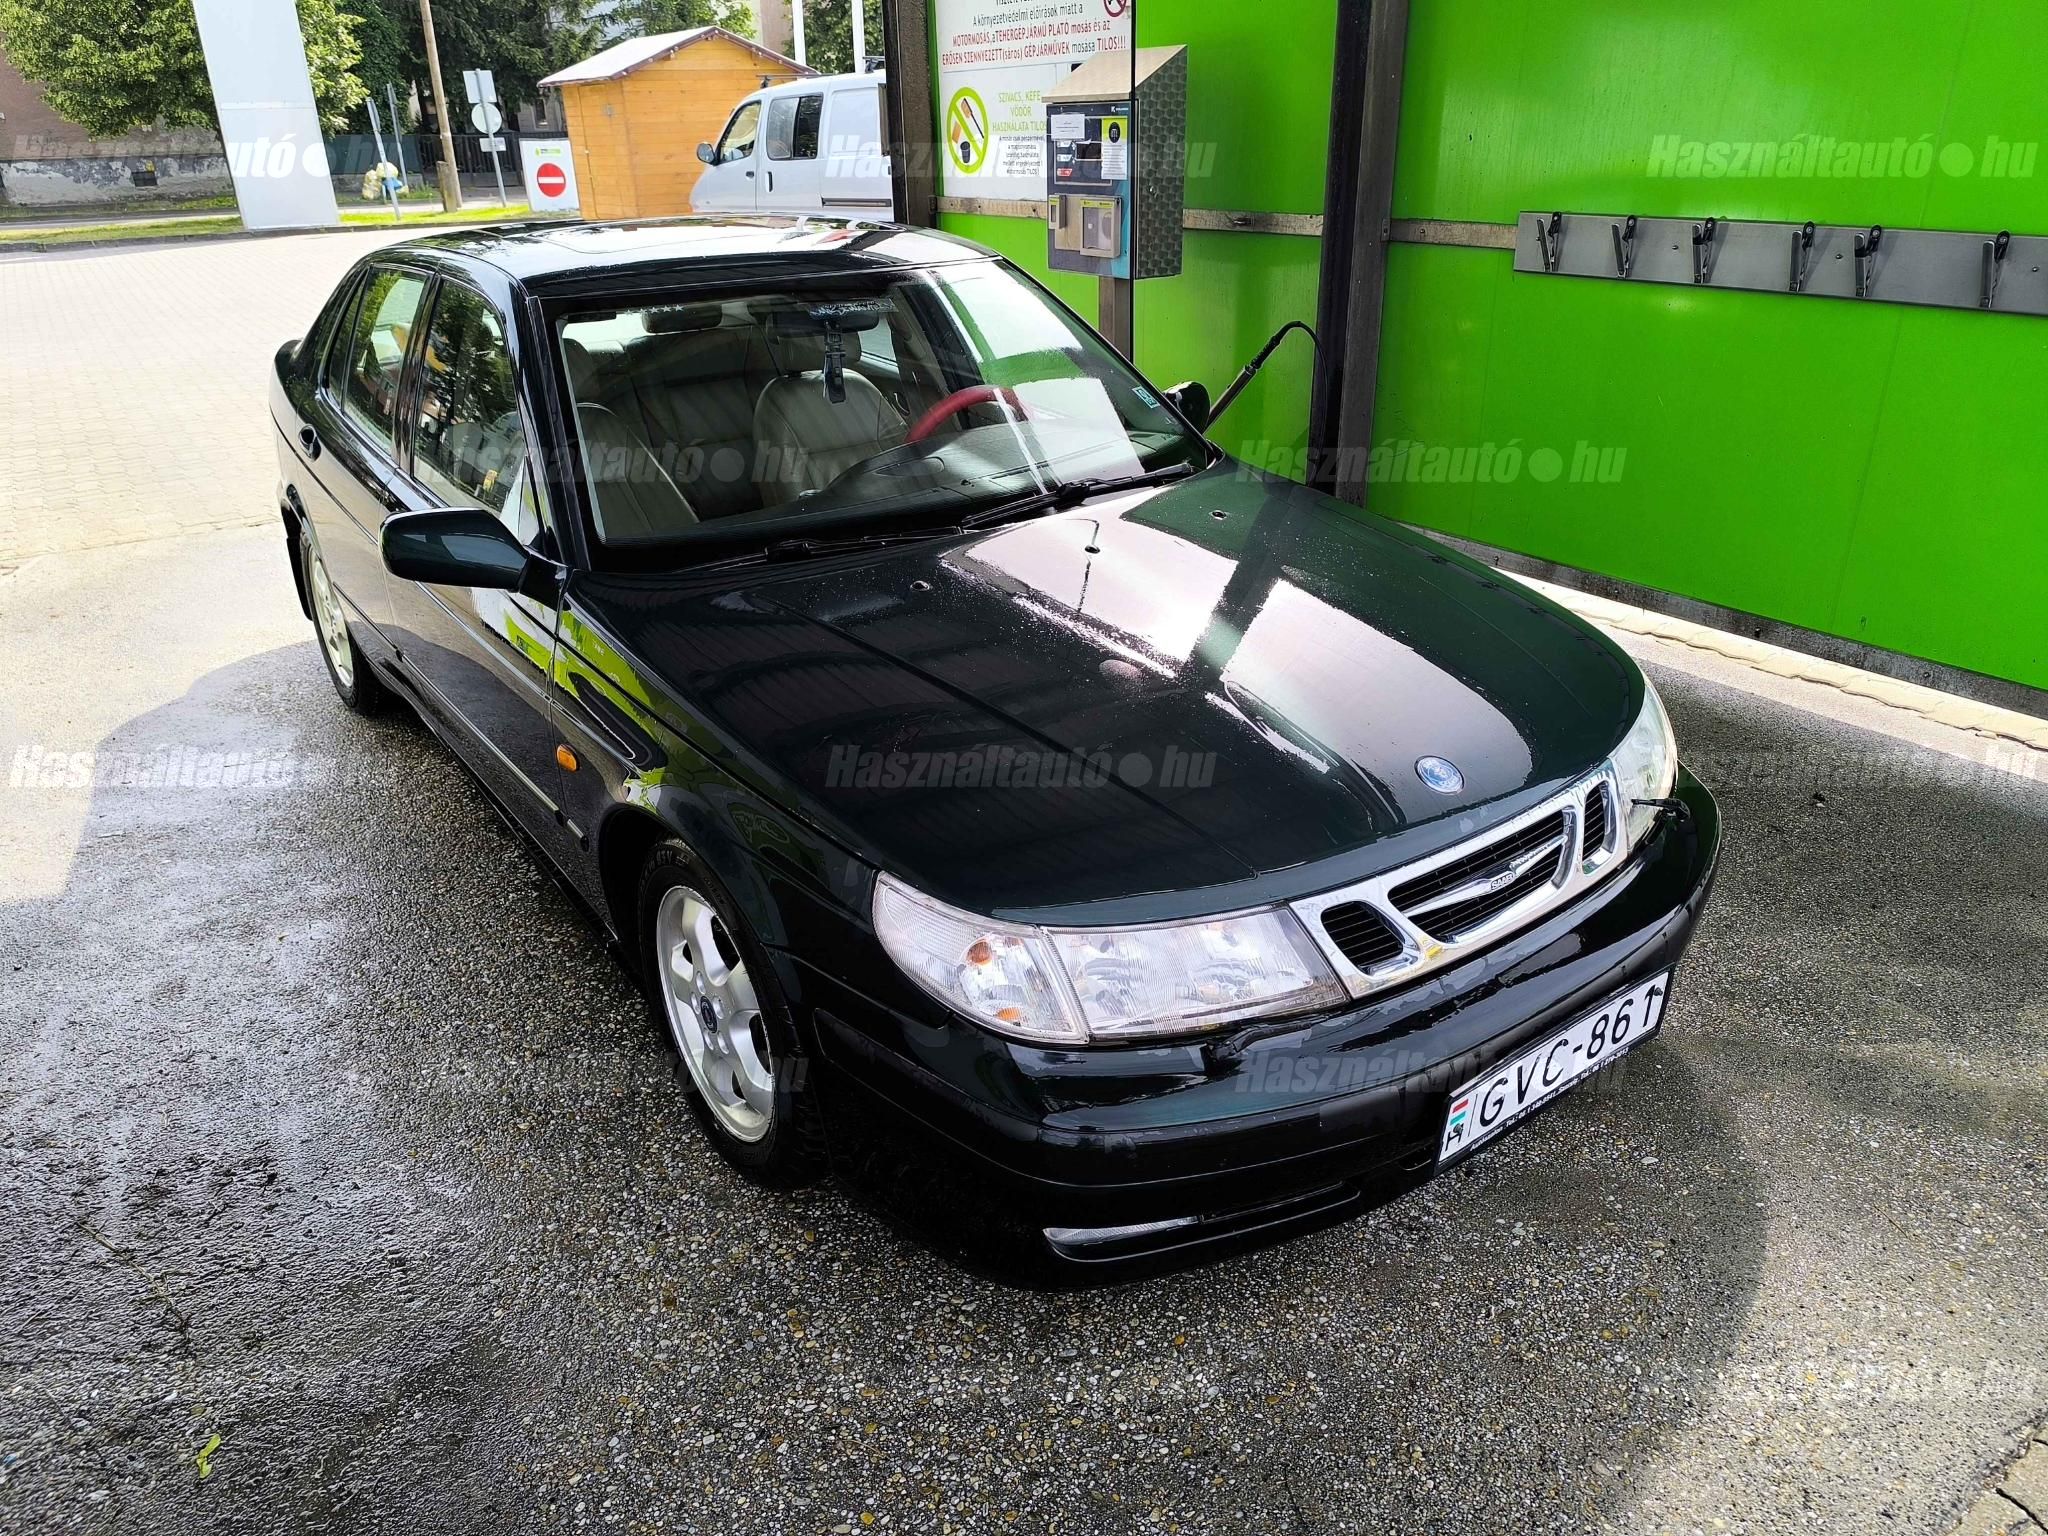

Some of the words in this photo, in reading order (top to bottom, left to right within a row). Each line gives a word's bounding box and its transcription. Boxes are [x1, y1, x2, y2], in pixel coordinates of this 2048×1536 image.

[1059, 3, 1077, 15] miatt
[1070, 19, 1091, 34] mosás
[1102, 20, 1111, 31] az
[1071, 38, 1096, 53] mosása
[1097, 35, 1126, 51] TILOS!!!
[1491, 873, 1514, 890] SAAB
[1479, 984, 1661, 1128] GVC-861
